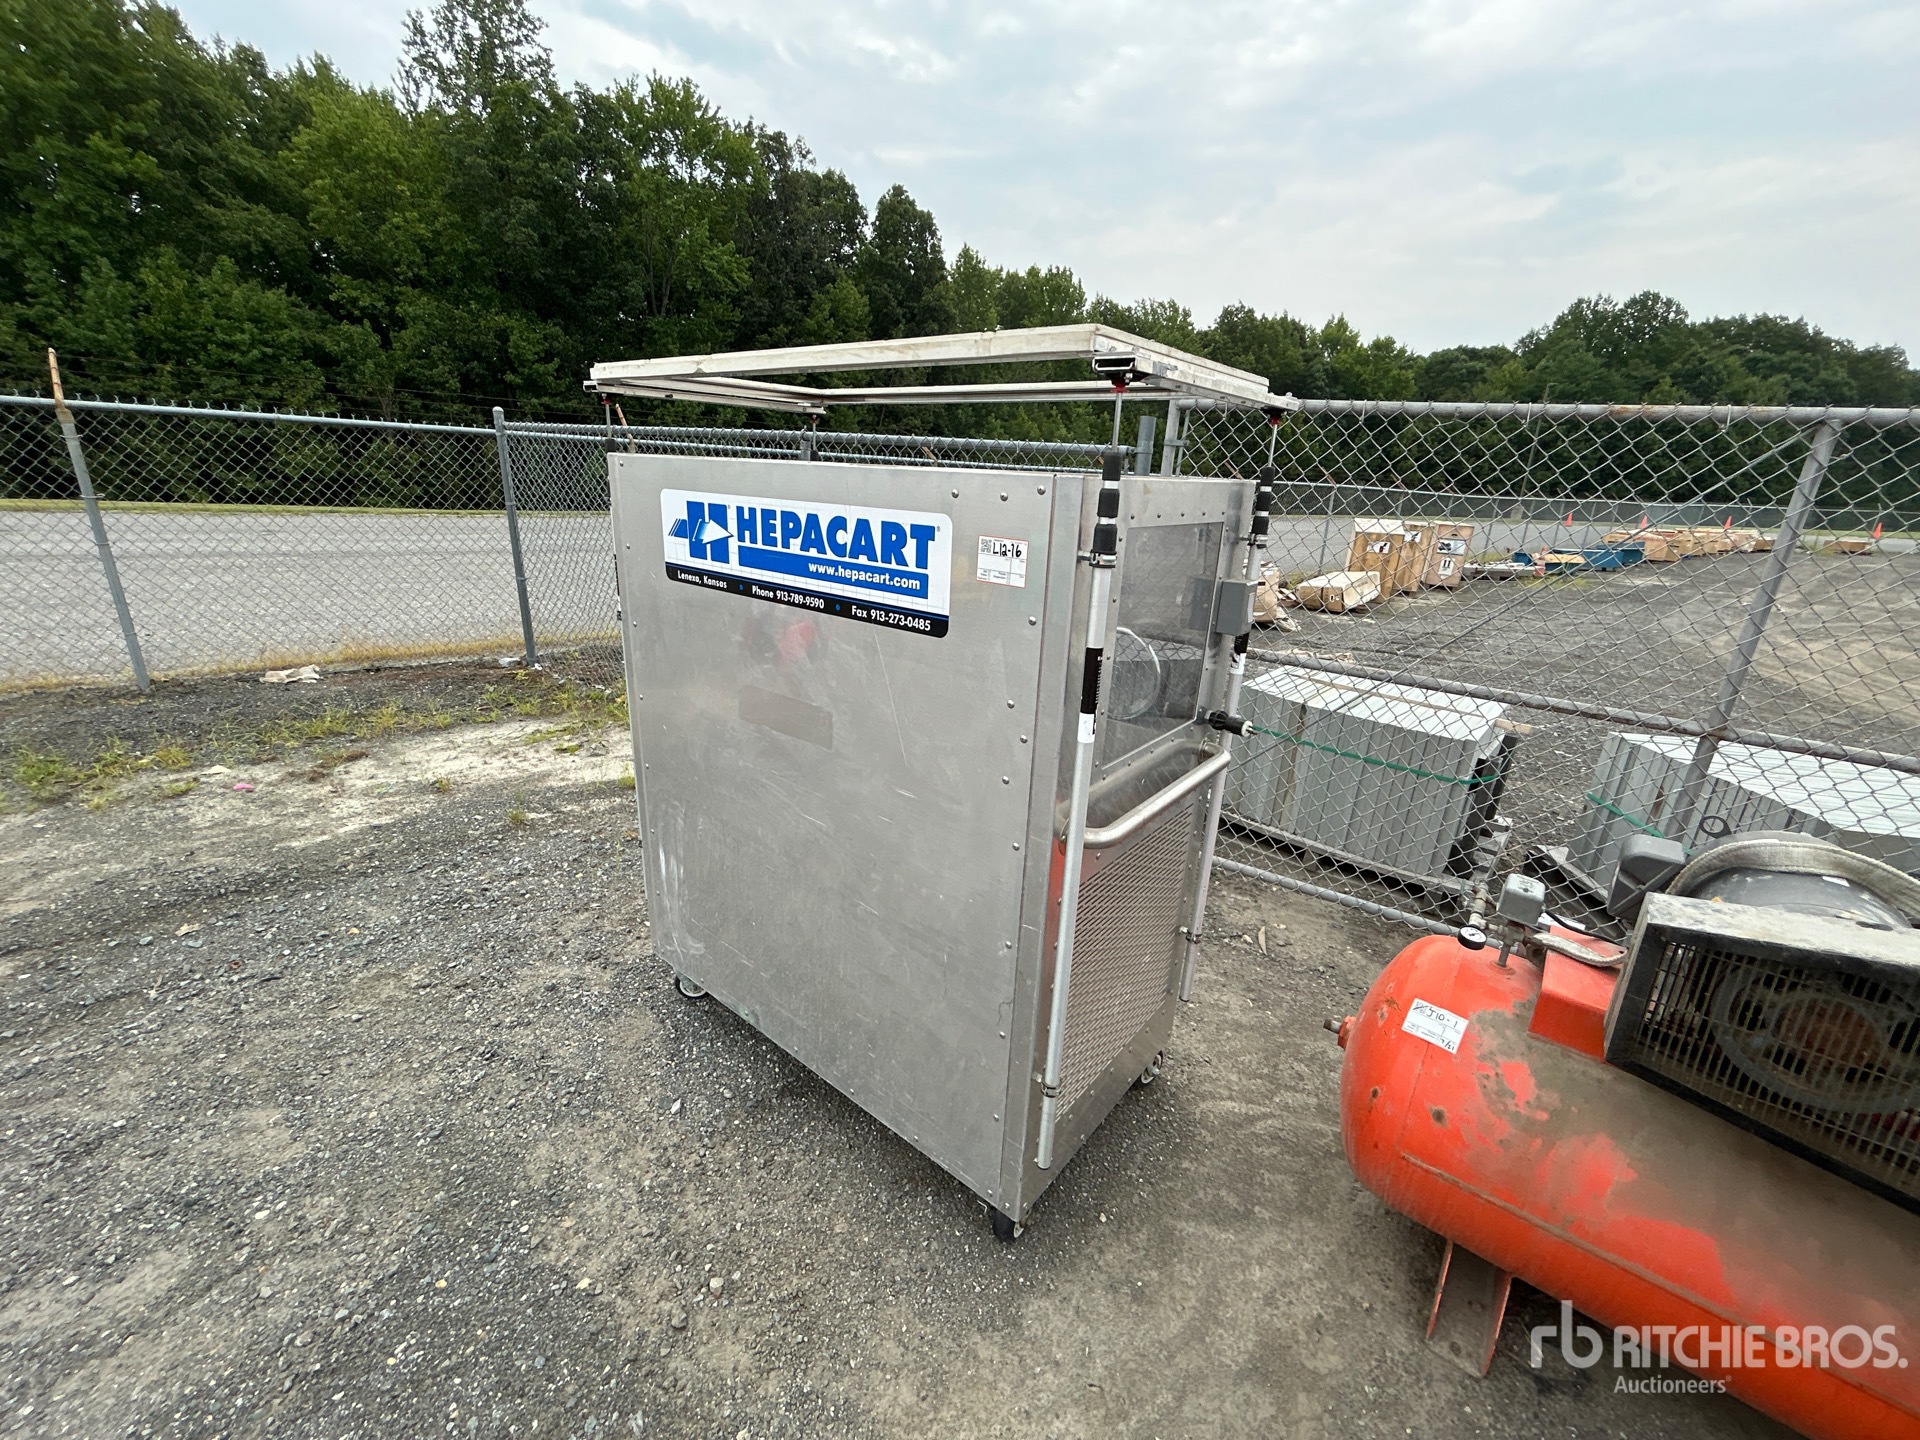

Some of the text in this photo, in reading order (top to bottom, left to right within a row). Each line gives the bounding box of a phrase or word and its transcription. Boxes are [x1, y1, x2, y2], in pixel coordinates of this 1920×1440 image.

[736, 505, 936, 570] HEPACART
[677, 570, 931, 631] Lenexa, Kansas Phone 913-789-9590 Fax 913-273-0485
[808, 563, 921, 590] www.hepacart.com
